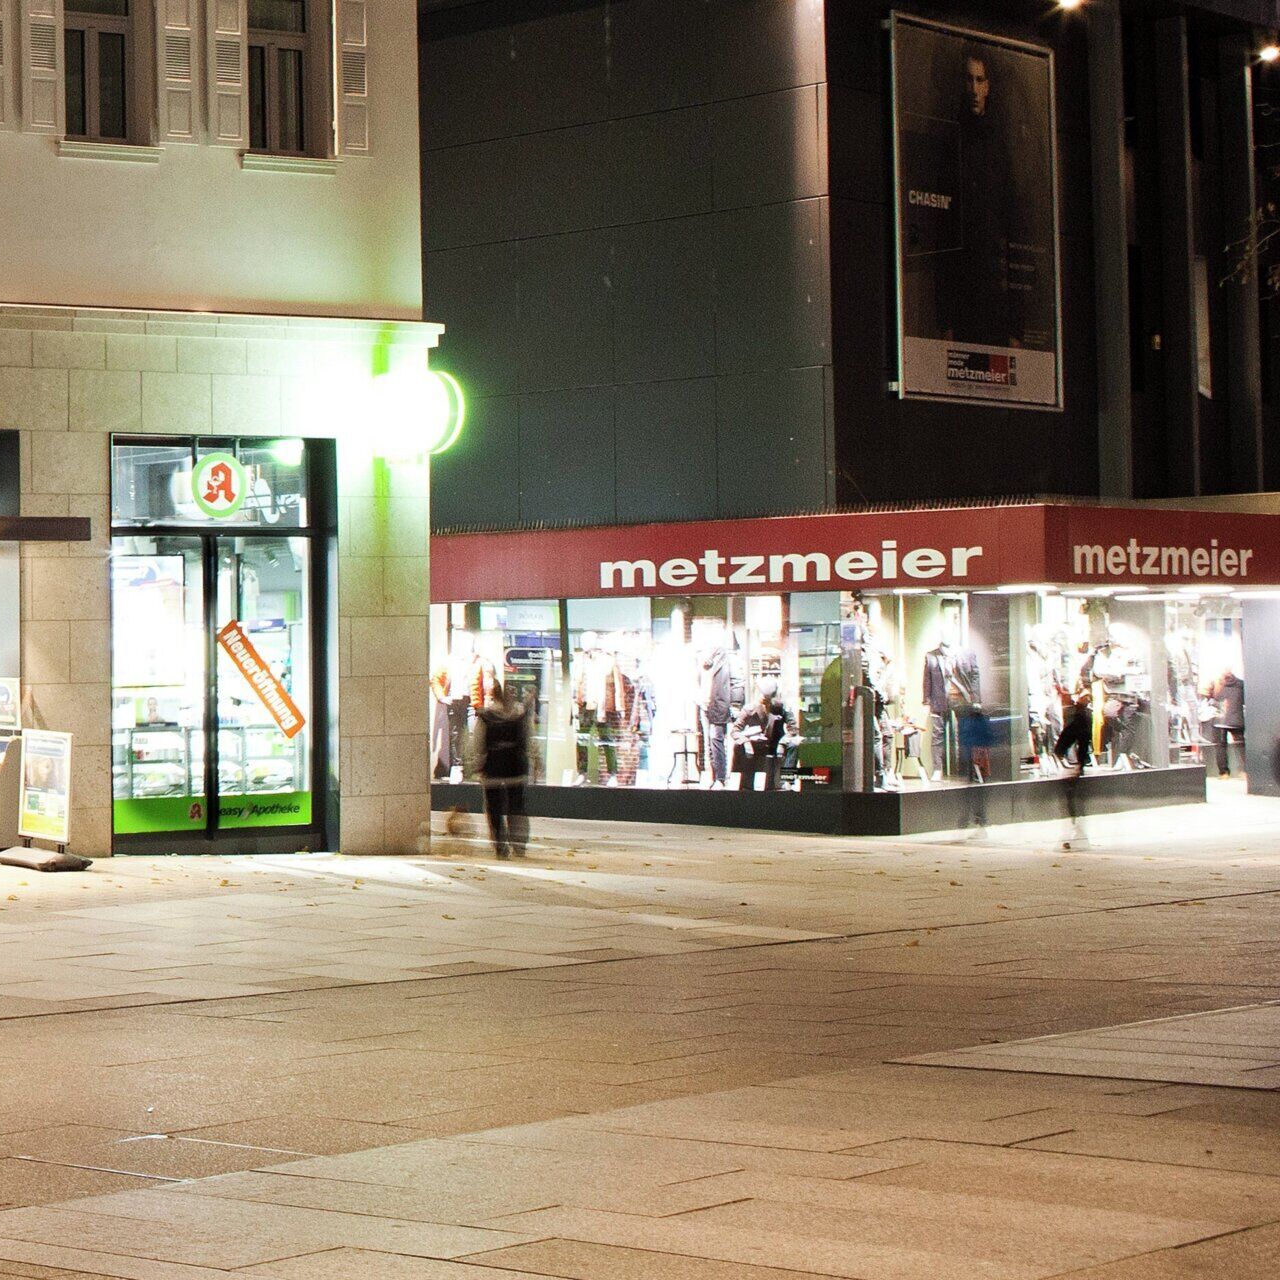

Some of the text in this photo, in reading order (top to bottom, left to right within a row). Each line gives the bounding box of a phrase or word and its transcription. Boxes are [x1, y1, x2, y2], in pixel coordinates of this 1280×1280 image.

[947, 366, 1007, 383] metzmeier
[599, 538, 984, 589] metzmeier
[1072, 537, 1254, 578] metzmeier
[222, 628, 300, 728] Neueröffnung
[249, 802, 301, 818] Apotheke
